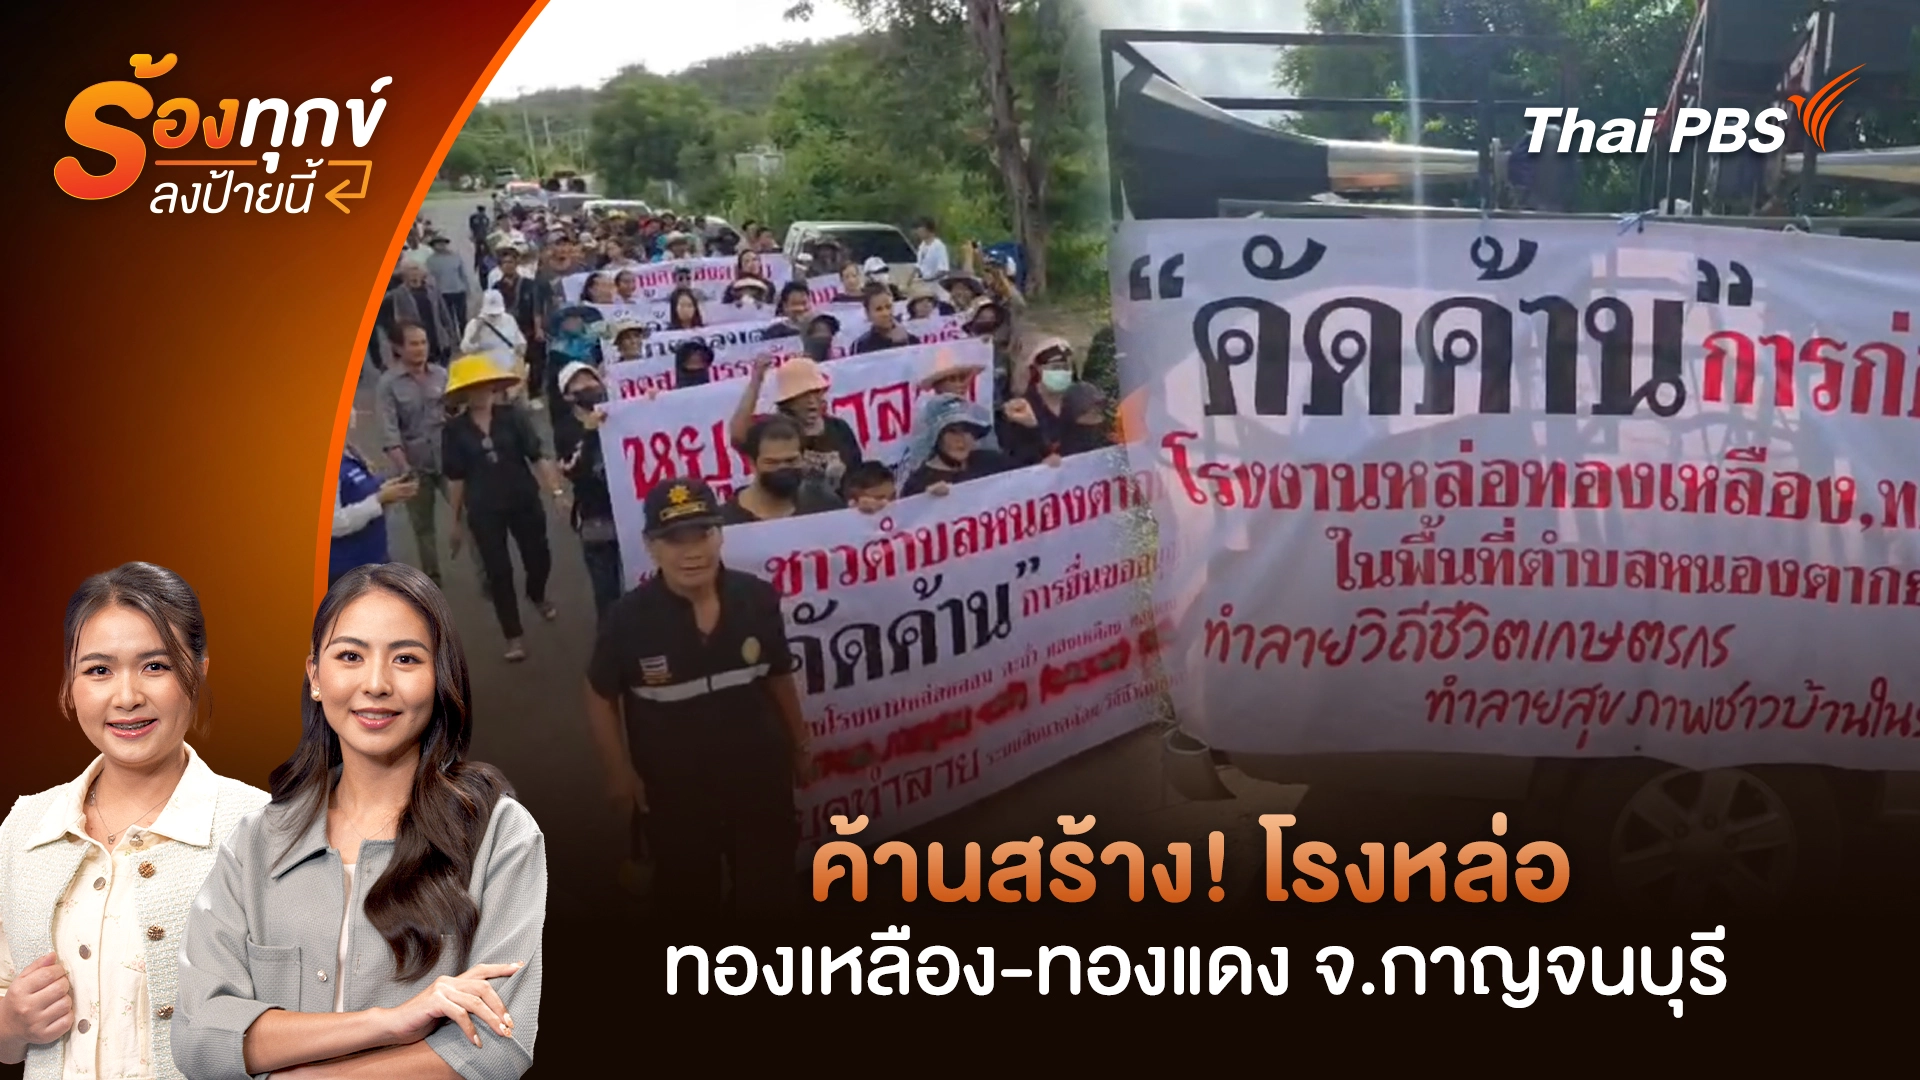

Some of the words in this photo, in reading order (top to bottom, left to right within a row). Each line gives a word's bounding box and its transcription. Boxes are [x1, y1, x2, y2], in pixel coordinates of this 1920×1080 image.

[1702, 311, 1920, 418] การก่
[1162, 431, 1920, 532] โรงงานหล่อทองเหลือง,ท
